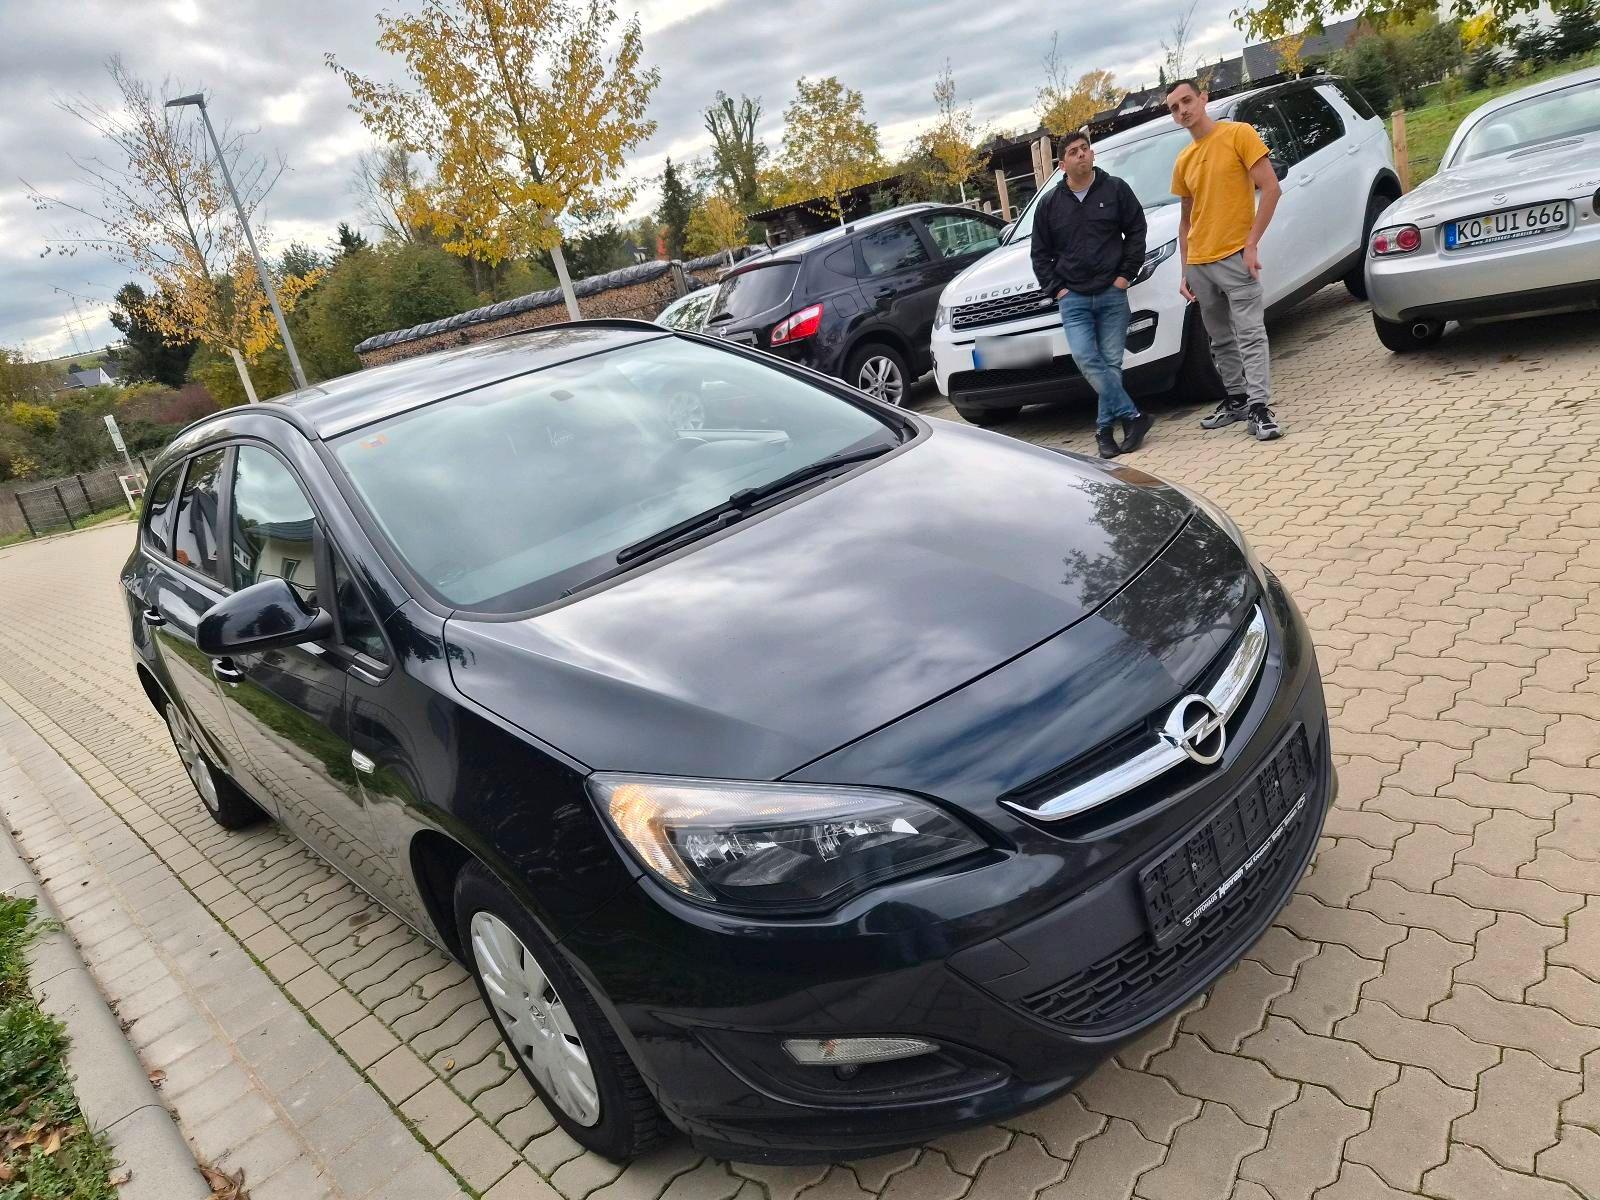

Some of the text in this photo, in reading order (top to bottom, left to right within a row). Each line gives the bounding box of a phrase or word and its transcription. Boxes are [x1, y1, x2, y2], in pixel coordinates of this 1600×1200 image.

[1457, 204, 1564, 241] KO UI 666
[965, 282, 1035, 303] DISCOVE
[1193, 893, 1218, 920] AUTOHAUS
